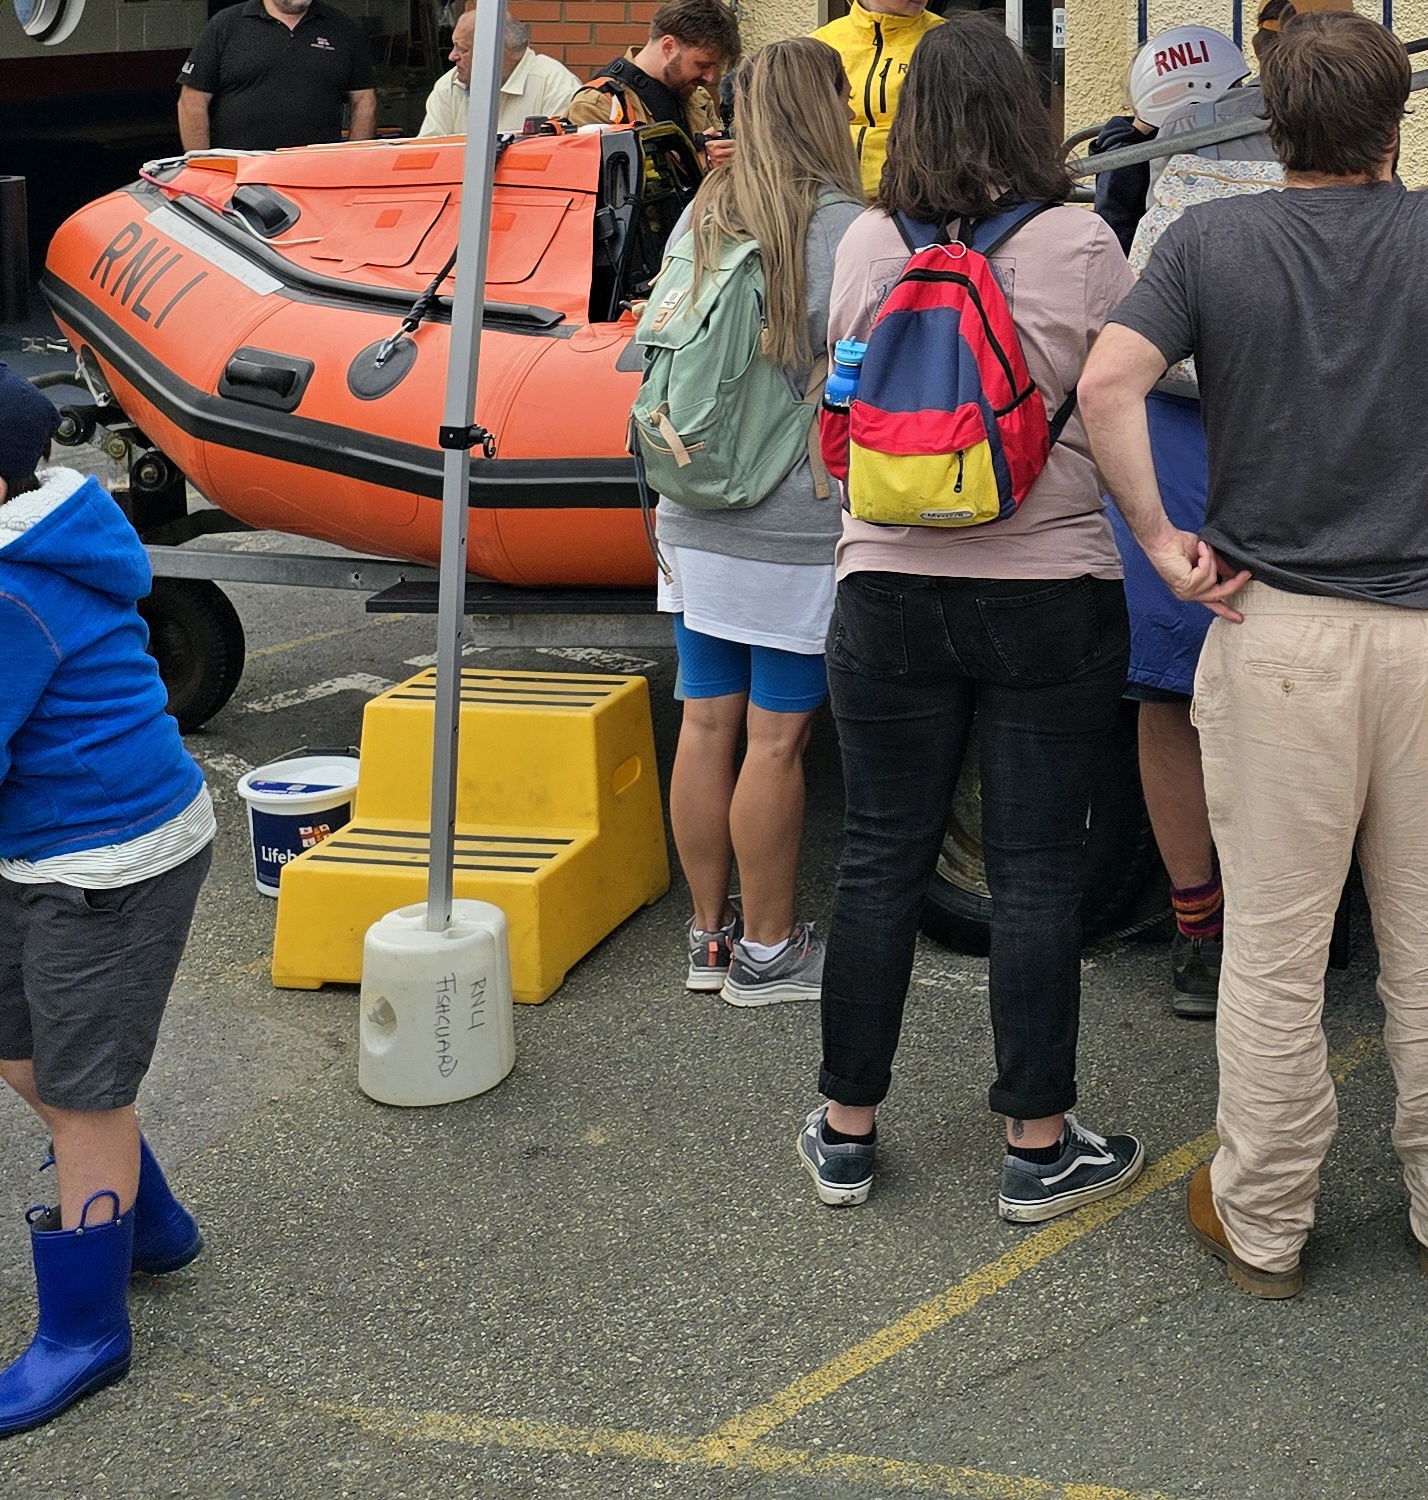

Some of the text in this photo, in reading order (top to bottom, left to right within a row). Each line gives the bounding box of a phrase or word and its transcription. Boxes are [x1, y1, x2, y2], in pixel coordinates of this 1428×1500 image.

[1153, 40, 1210, 77] RNLI
[90, 221, 209, 329] RNLI
[261, 845, 299, 865] Lifeb
